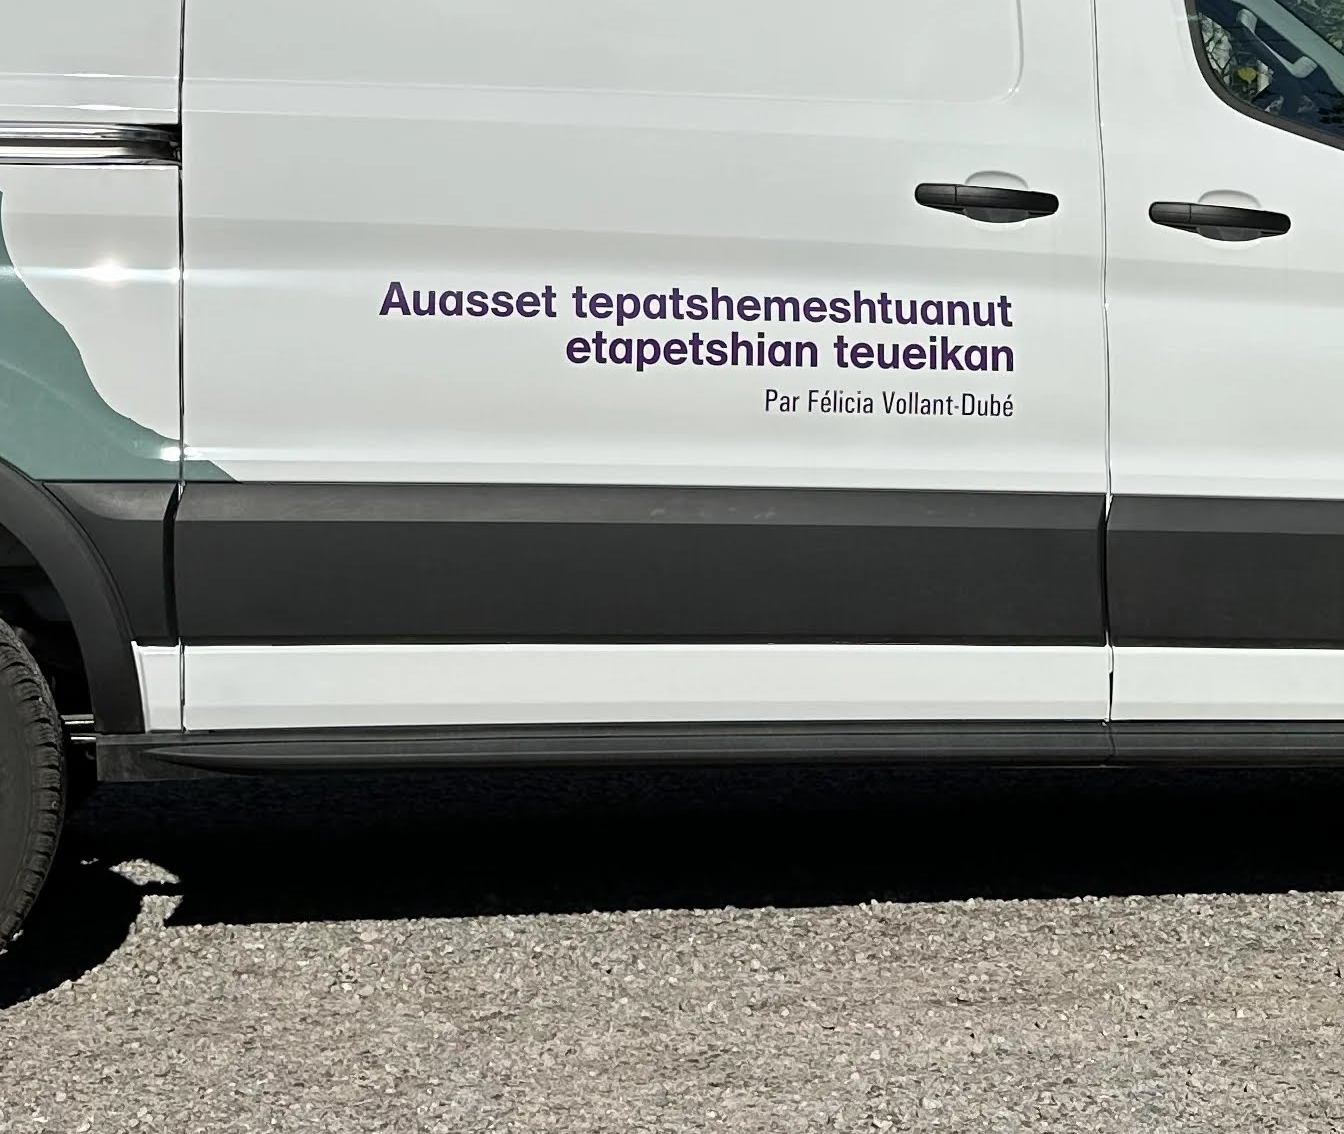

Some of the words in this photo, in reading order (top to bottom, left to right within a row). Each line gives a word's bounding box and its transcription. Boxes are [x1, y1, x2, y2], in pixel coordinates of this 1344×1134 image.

[378, 281, 557, 318] Auasset
[571, 285, 1013, 328] tepatshemeshtuanut
[565, 330, 818, 373] etapetshian
[833, 334, 1014, 372] teueikan
[765, 388, 800, 413] Par
[807, 387, 874, 414] Félicia
[882, 390, 1014, 417] Vollant-Dubé
